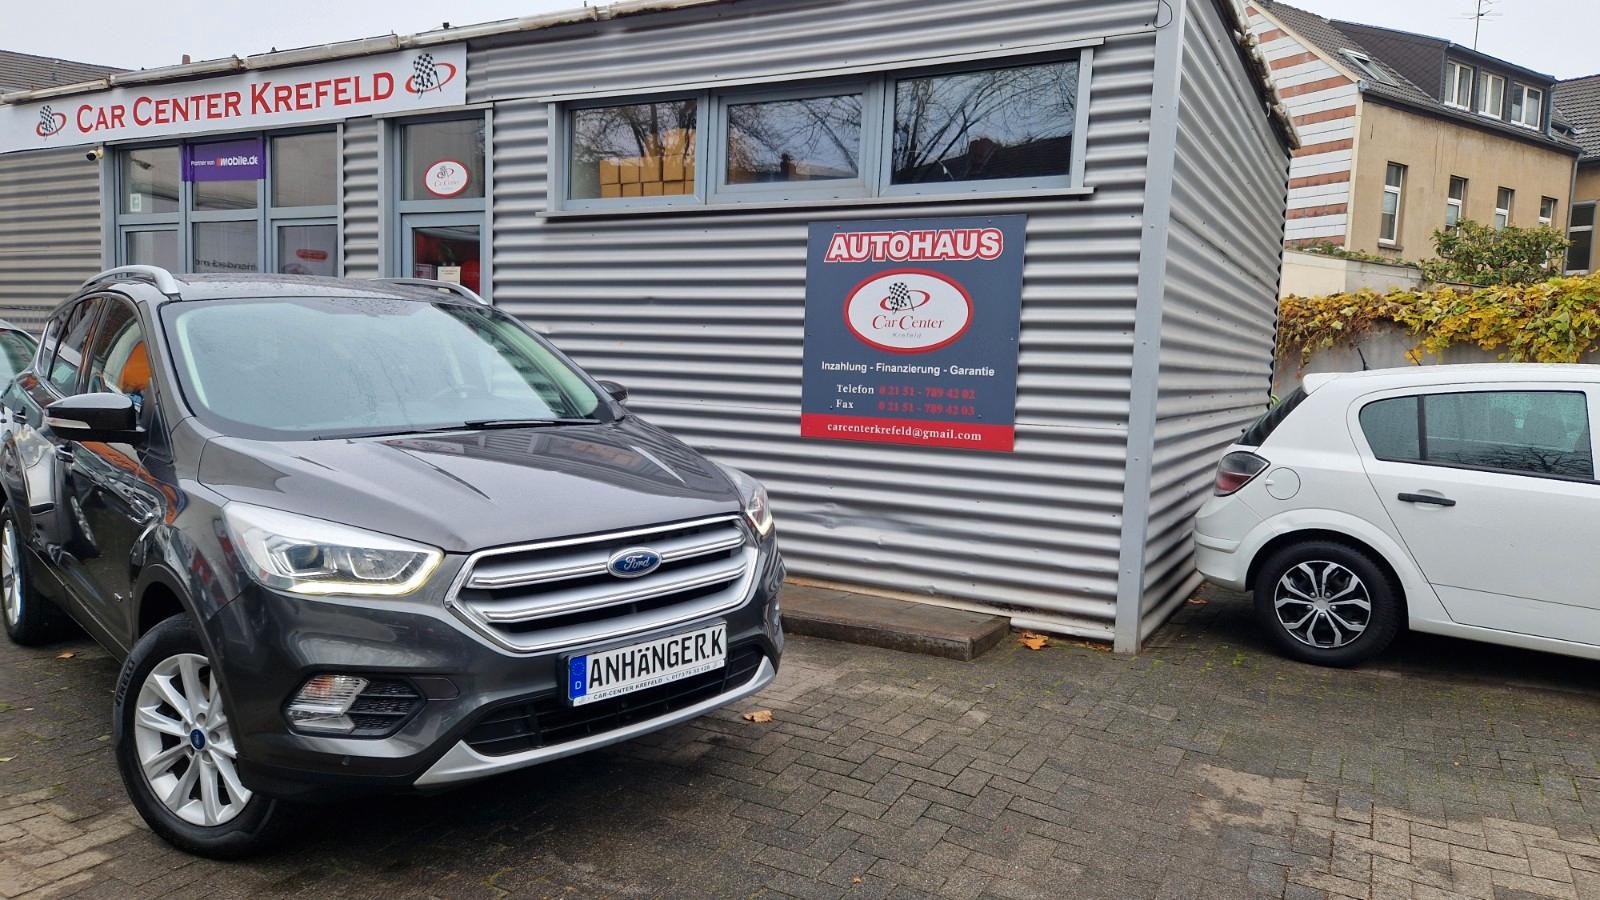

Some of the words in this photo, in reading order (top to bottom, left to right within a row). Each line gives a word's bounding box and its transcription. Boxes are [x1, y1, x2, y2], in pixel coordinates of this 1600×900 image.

[76, 104, 126, 134] CAR
[132, 91, 241, 126] CENTER
[251, 71, 395, 115] KREFELD
[825, 228, 1003, 262] AUTOHAUS
[872, 314, 897, 330] Car
[899, 314, 944, 330] Center
[821, 361, 867, 373] Inzahlung
[876, 363, 940, 376] Finanzierung
[950, 365, 995, 377] Garantie
[836, 384, 874, 395] Telefon
[879, 386, 884, 395] 0
[888, 386, 899, 396] 21
[902, 387, 914, 396] 51
[926, 388, 944, 398] 789
[947, 389, 959, 399] 42
[836, 399, 854, 409] Fax
[879, 401, 884, 411] 0
[888, 402, 899, 411] 21
[902, 402, 913, 412] 51
[925, 404, 943, 414] 789
[946, 405, 959, 415] 42
[827, 423, 982, 441] carcenterkrefeld@gmail.com
[623, 554, 650, 570] Ford
[589, 628, 723, 689] ANHÄNGER.K
[575, 680, 582, 690] D
[593, 685, 634, 700] CAR-CENTER
[635, 678, 663, 690] KREFELD
